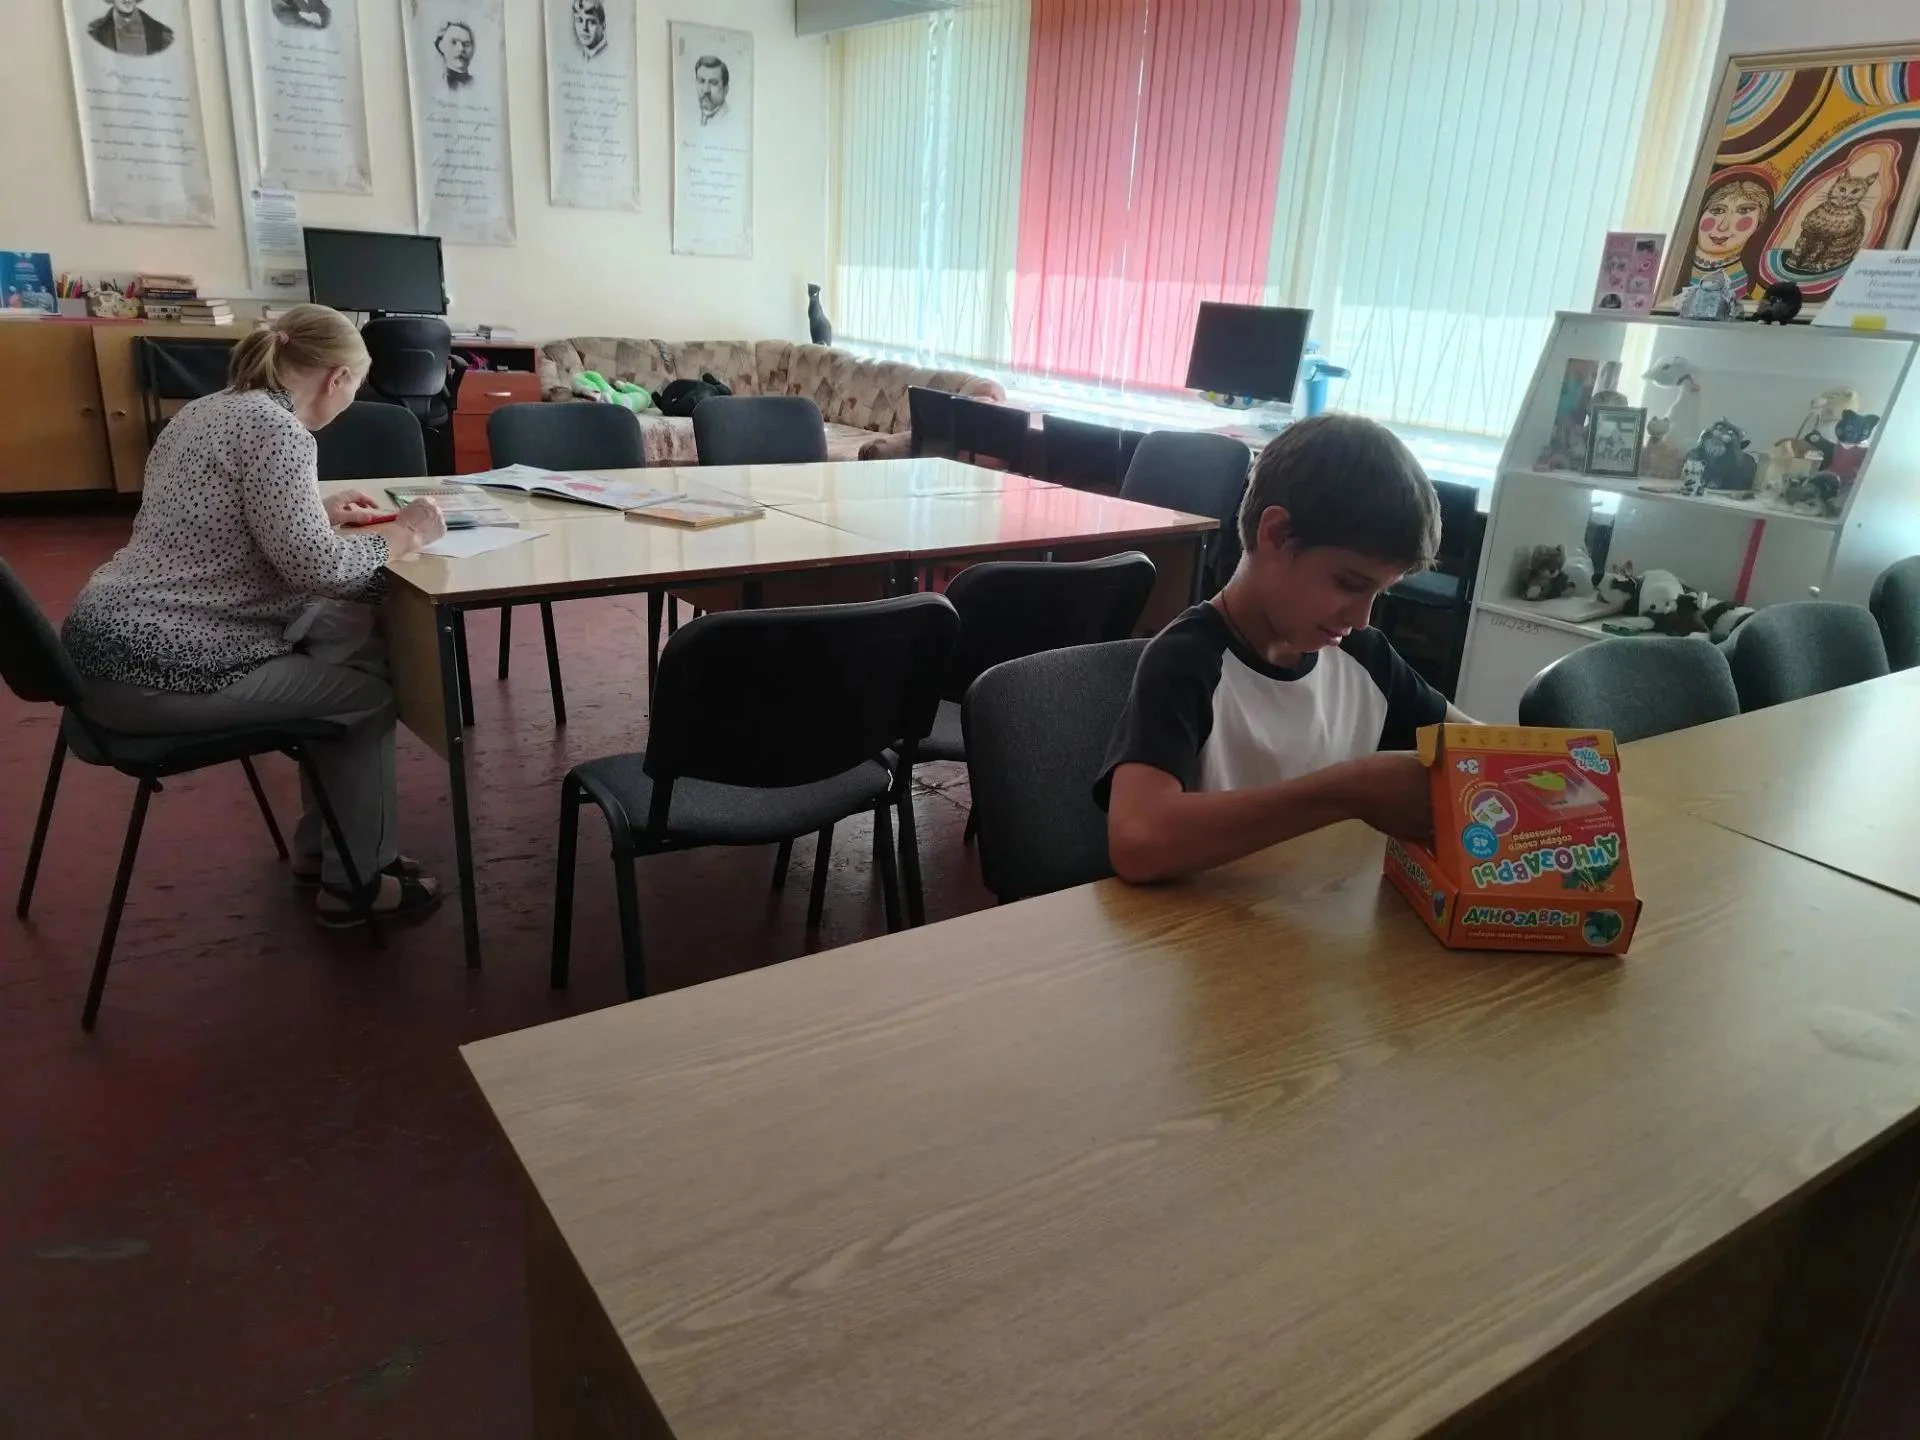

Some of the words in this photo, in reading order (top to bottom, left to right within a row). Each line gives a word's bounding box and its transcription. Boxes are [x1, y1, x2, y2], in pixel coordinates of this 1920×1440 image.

[1456, 758, 1480, 775] 3+
[1472, 832, 1622, 889] ДИНОЗАВРЫ
[1462, 906, 1580, 928] ДИНОЗАВРЫ
